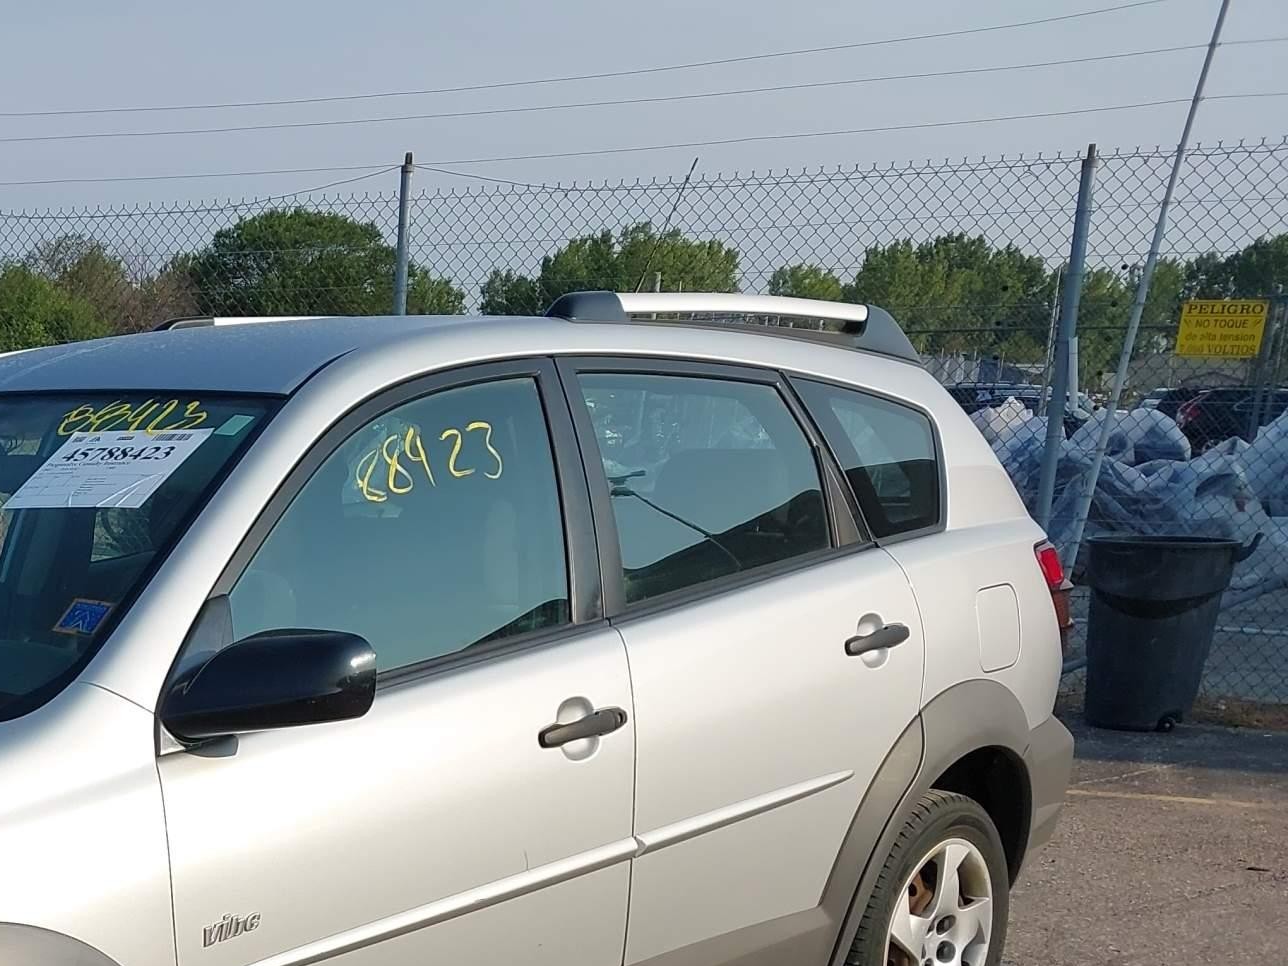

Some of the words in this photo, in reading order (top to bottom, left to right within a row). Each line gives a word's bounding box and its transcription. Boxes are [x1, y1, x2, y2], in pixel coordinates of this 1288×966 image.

[1186, 304, 1265, 315] PELIGRO
[1195, 319, 1210, 329] NO
[1214, 319, 1249, 329] TOQUE
[1207, 344, 1257, 355] VOLTIOS
[61, 446, 176, 462] 45788423
